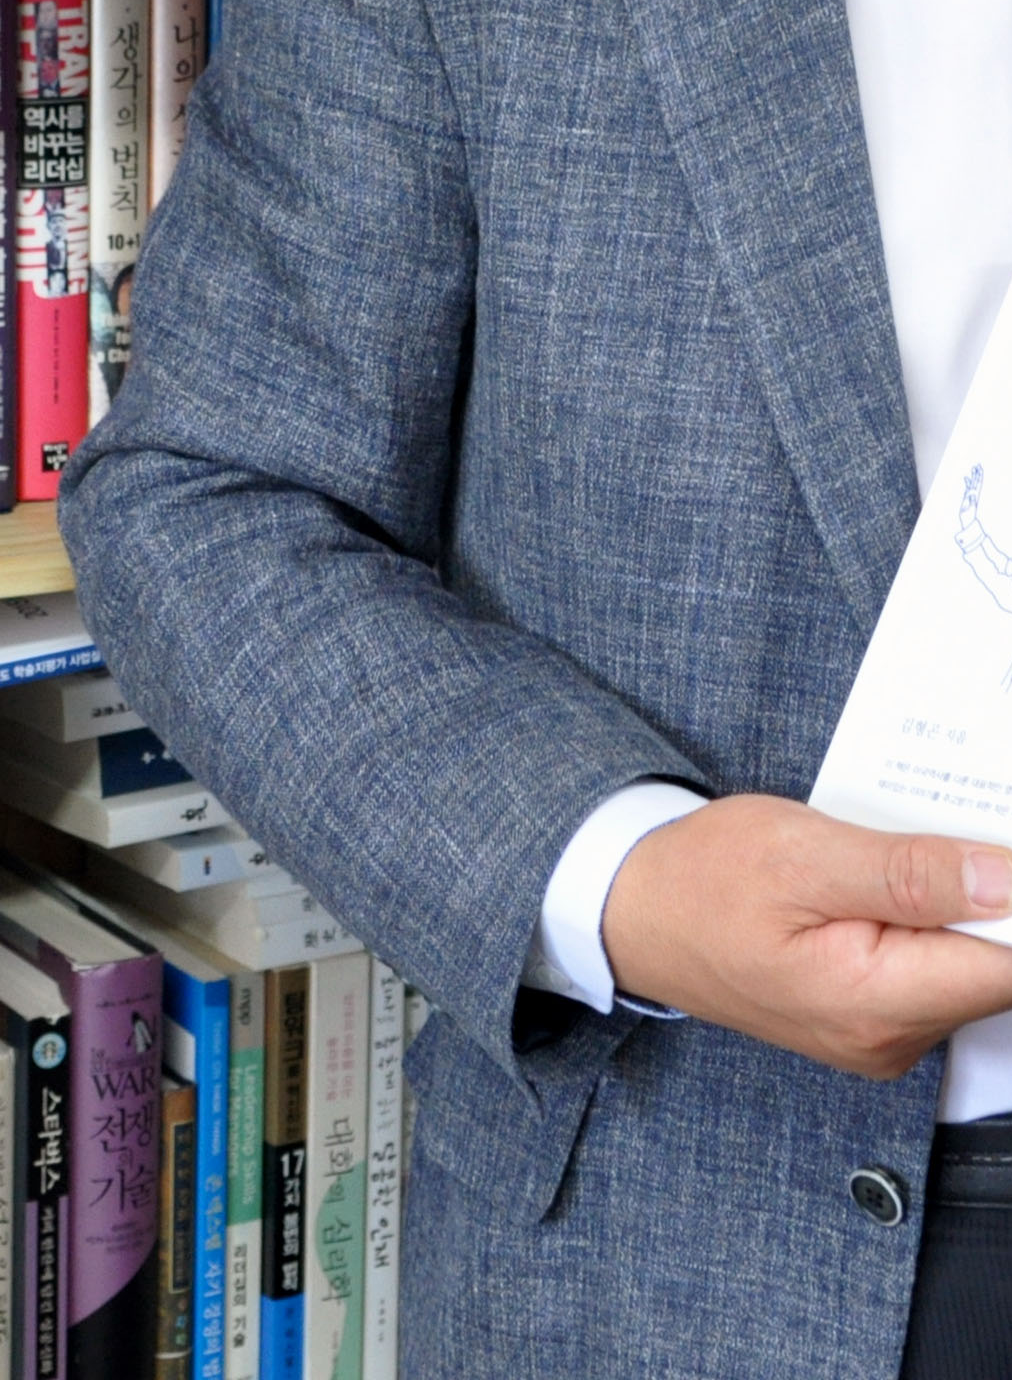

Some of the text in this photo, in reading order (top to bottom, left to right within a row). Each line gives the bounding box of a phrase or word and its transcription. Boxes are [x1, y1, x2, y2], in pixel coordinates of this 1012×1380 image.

[24, 104, 87, 132] 역사를
[110, 21, 142, 221] 생각의 법칙
[24, 132, 87, 158] 바꾸는
[24, 159, 87, 184] 리더십
[92, 1066, 156, 1101] WAR
[33, 1086, 63, 1195] 스타벅스
[241, 1063, 259, 1206] Leadership Skills
[89, 1166, 156, 1214] 기술
[321, 1115, 356, 1307] 대화의 심리학
[371, 1217, 395, 1269] 인재
